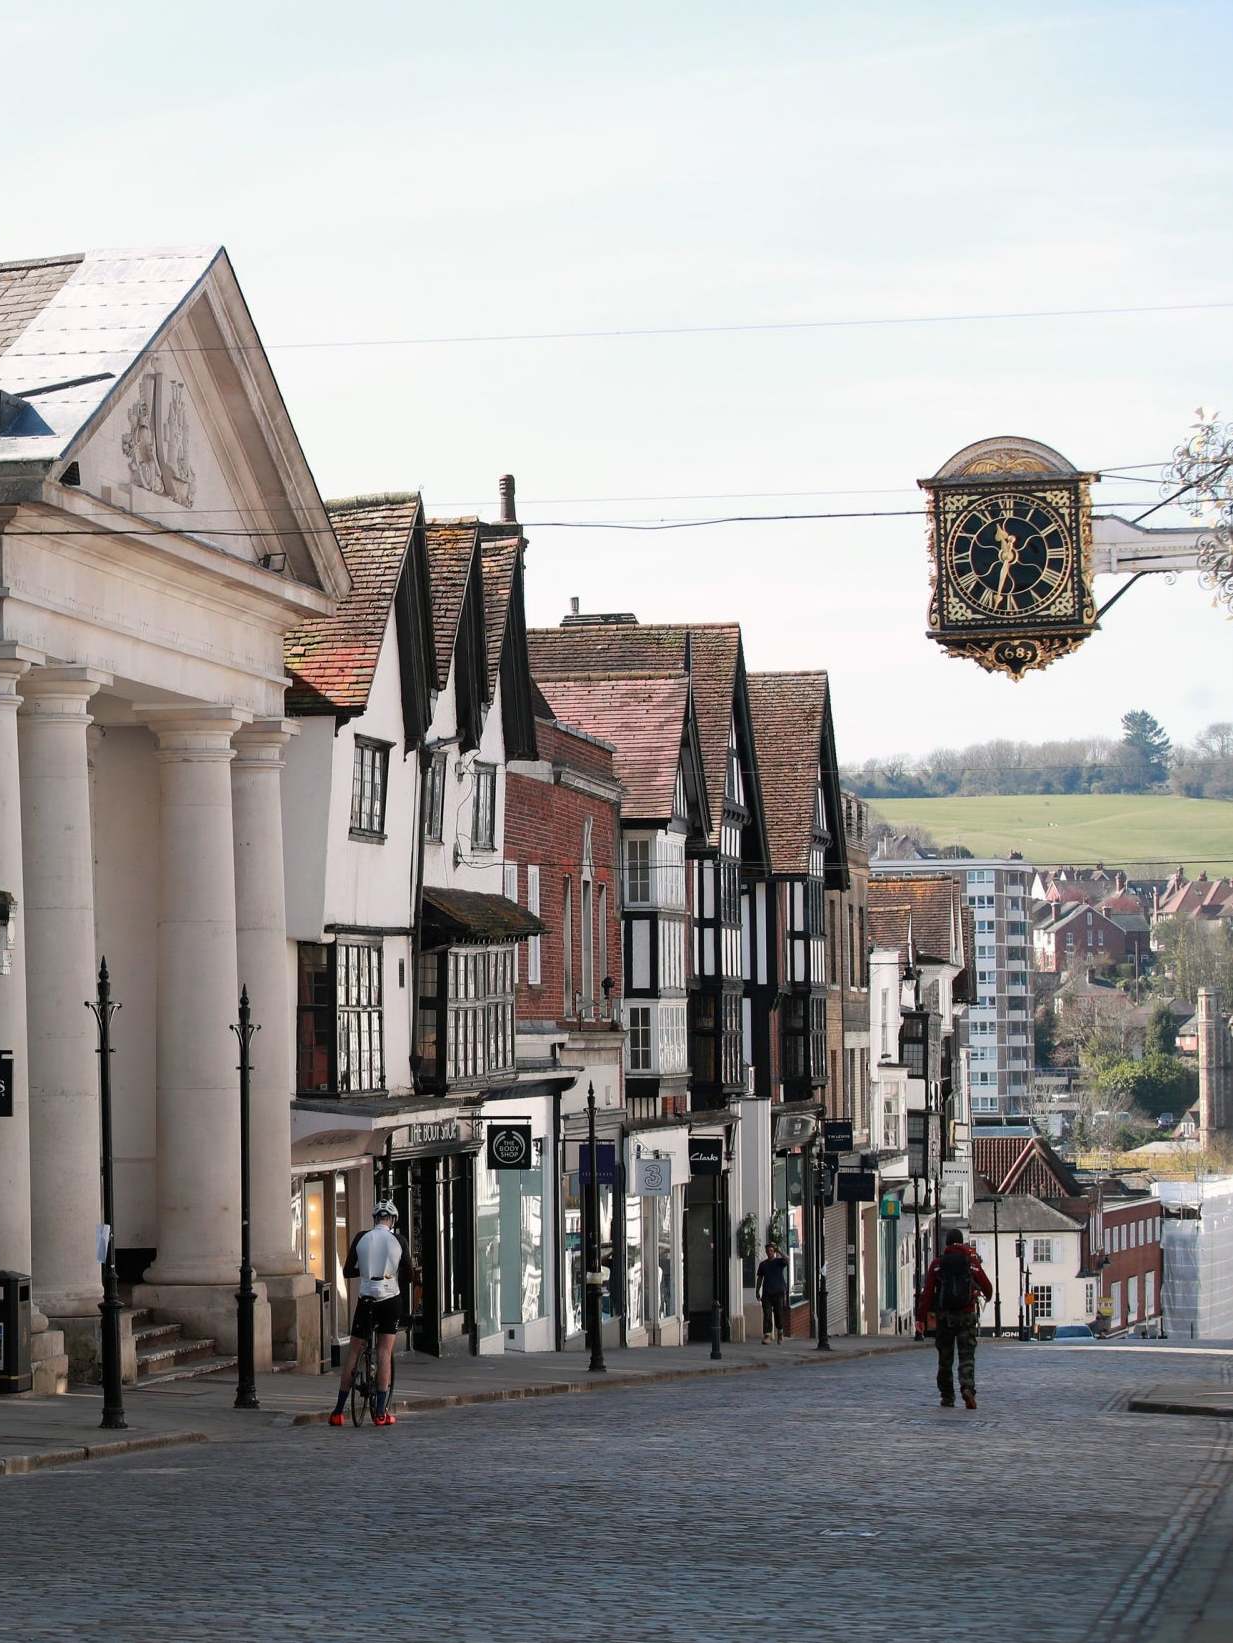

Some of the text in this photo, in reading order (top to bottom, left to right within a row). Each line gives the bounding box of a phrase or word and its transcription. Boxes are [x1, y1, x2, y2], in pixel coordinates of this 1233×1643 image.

[998, 647, 1032, 662] 1683
[690, 1152, 719, 1162] Clarks
[644, 1164, 663, 1188] 3
